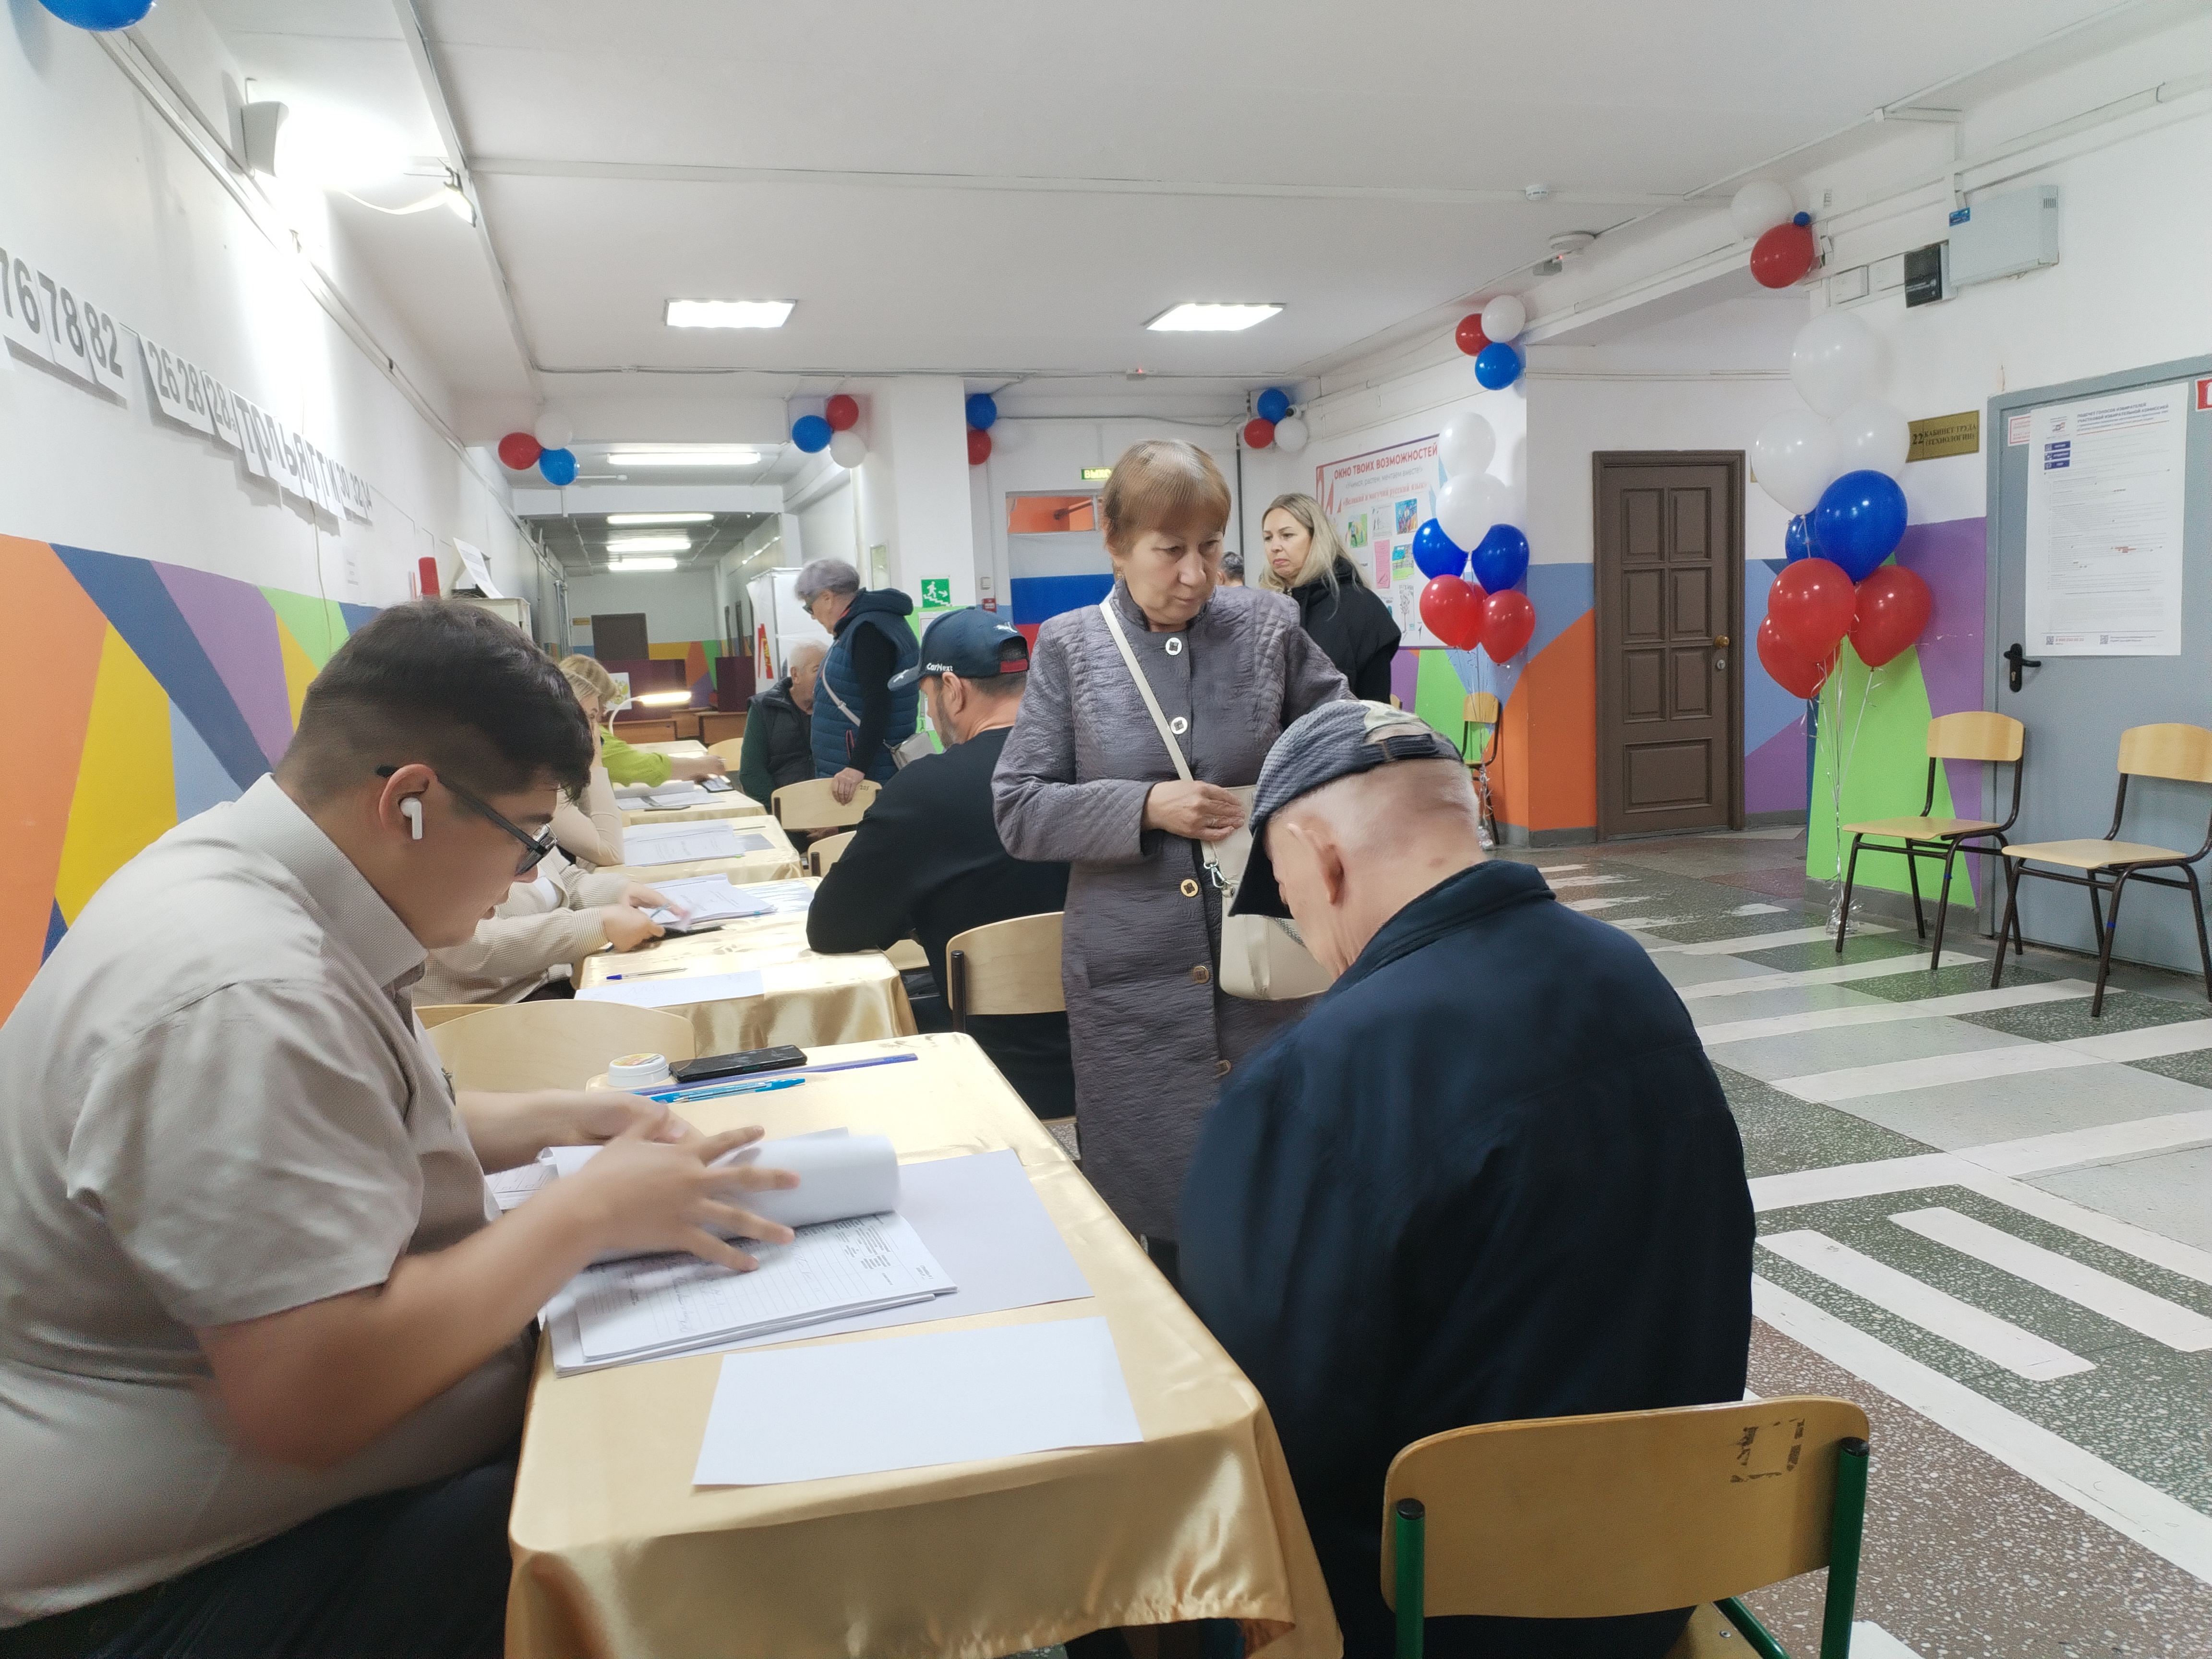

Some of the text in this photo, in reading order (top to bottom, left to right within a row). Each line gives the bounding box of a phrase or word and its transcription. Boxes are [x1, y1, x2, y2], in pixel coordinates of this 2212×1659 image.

[0, 247, 124, 379] 76 78 82
[147, 340, 180, 404] 26
[177, 357, 205, 416] 28
[1912, 433, 1924, 445] 22
[1334, 442, 1438, 480] ОКНО ТВОИХ ВОЗМОЖНОСТЕЙ
[1084, 469, 1112, 479] ВЫХО
[926, 662, 953, 672] CarNext
